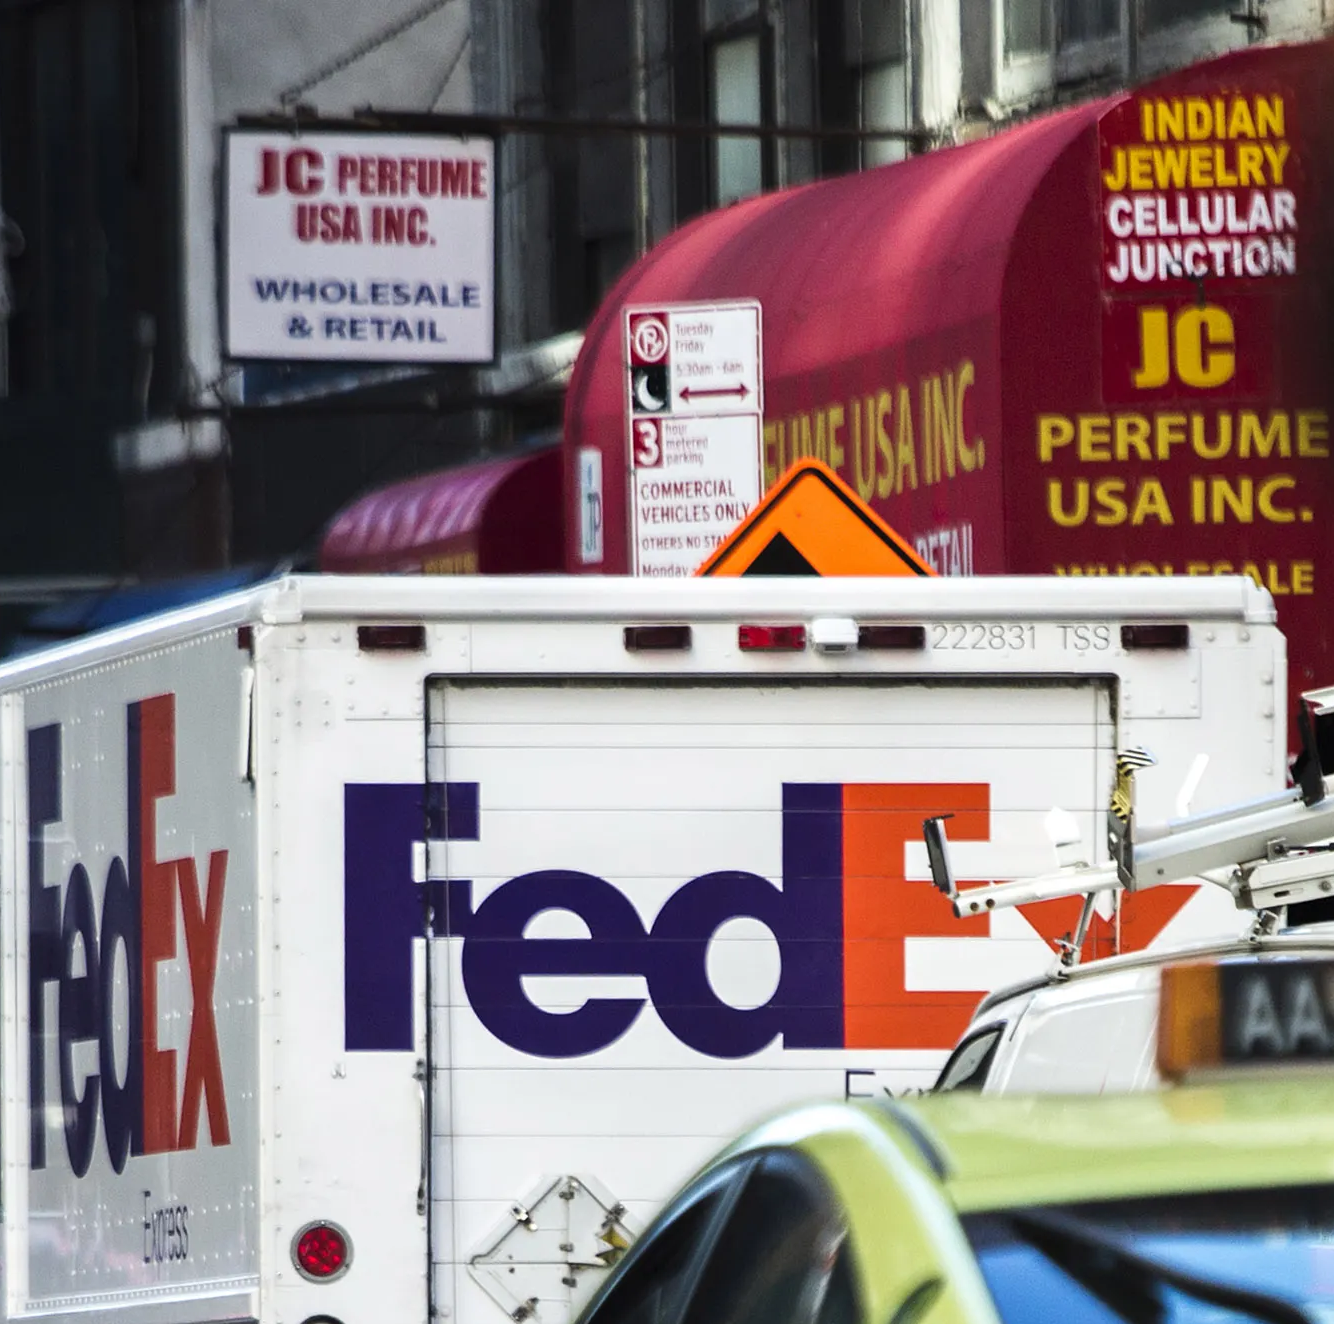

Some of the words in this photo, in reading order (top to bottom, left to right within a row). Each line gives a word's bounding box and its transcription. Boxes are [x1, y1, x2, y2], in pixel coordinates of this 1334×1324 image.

[1141, 96, 1285, 142] INDIAN
[256, 146, 323, 197] JC
[338, 155, 488, 198] PERFUME
[1103, 143, 1290, 191] JEWELRY
[293, 205, 362, 245] USA
[371, 206, 436, 247] INC.
[1109, 190, 1298, 238] CELLULAR
[1109, 237, 1296, 282] JUNCTION
[255, 277, 480, 308] WHOLESALE
[288, 315, 312, 340] &
[324, 317, 447, 343] RETAIL
[676, 324, 713, 338] Tuesday
[1132, 304, 1235, 389] JC
[676, 341, 704, 355] Friday
[723, 360, 744, 374] 6am
[637, 420, 659, 466] 3
[665, 424, 687, 436] hour
[666, 437, 708, 448] metered
[851, 385, 917, 504] USA
[920, 360, 985, 485] INC.
[1038, 410, 1330, 462] PERFUME
[667, 452, 703, 467] parking
[641, 479, 734, 500] COMMERCIAL
[1048, 479, 1173, 527] USA
[1192, 476, 1314, 525] INC.
[642, 504, 710, 524] VEHICLES
[715, 502, 750, 521] ONLY
[642, 536, 682, 551] OTHERS
[686, 534, 701, 548] NO
[642, 564, 688, 577] Monday
[932, 623, 1036, 650] 222831
[1057, 623, 1111, 650] TSS
[28, 692, 231, 1178] FedEx
[144, 1190, 189, 1265] Express
